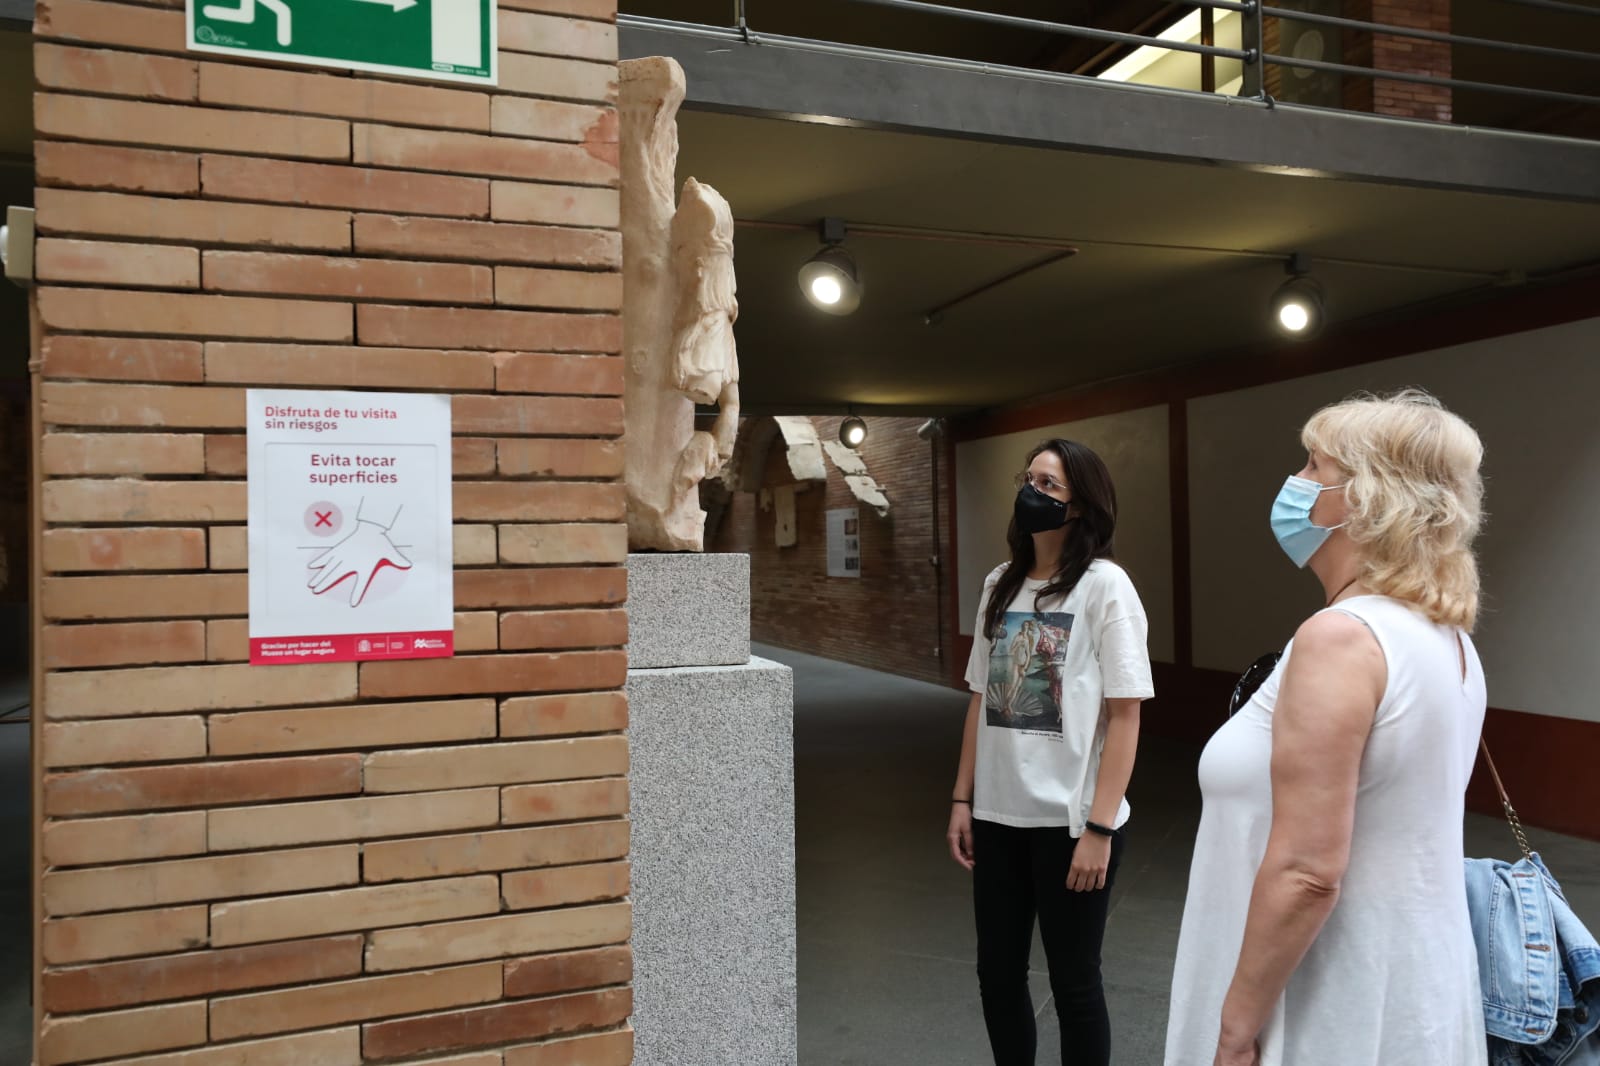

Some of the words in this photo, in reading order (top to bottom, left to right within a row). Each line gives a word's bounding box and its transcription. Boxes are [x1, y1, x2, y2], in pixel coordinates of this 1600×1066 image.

[264, 406, 321, 418] Disfruta
[324, 407, 341, 418] de
[344, 408, 358, 419] tu
[361, 407, 398, 420] visita
[264, 418, 285, 429] sin
[289, 418, 338, 433] riesgos
[310, 453, 352, 467] Evita
[355, 454, 397, 467] tocar
[309, 470, 398, 486] superficies
[320, 639, 332, 647] del
[294, 648, 312, 656] lugar
[313, 647, 336, 656] seguro
